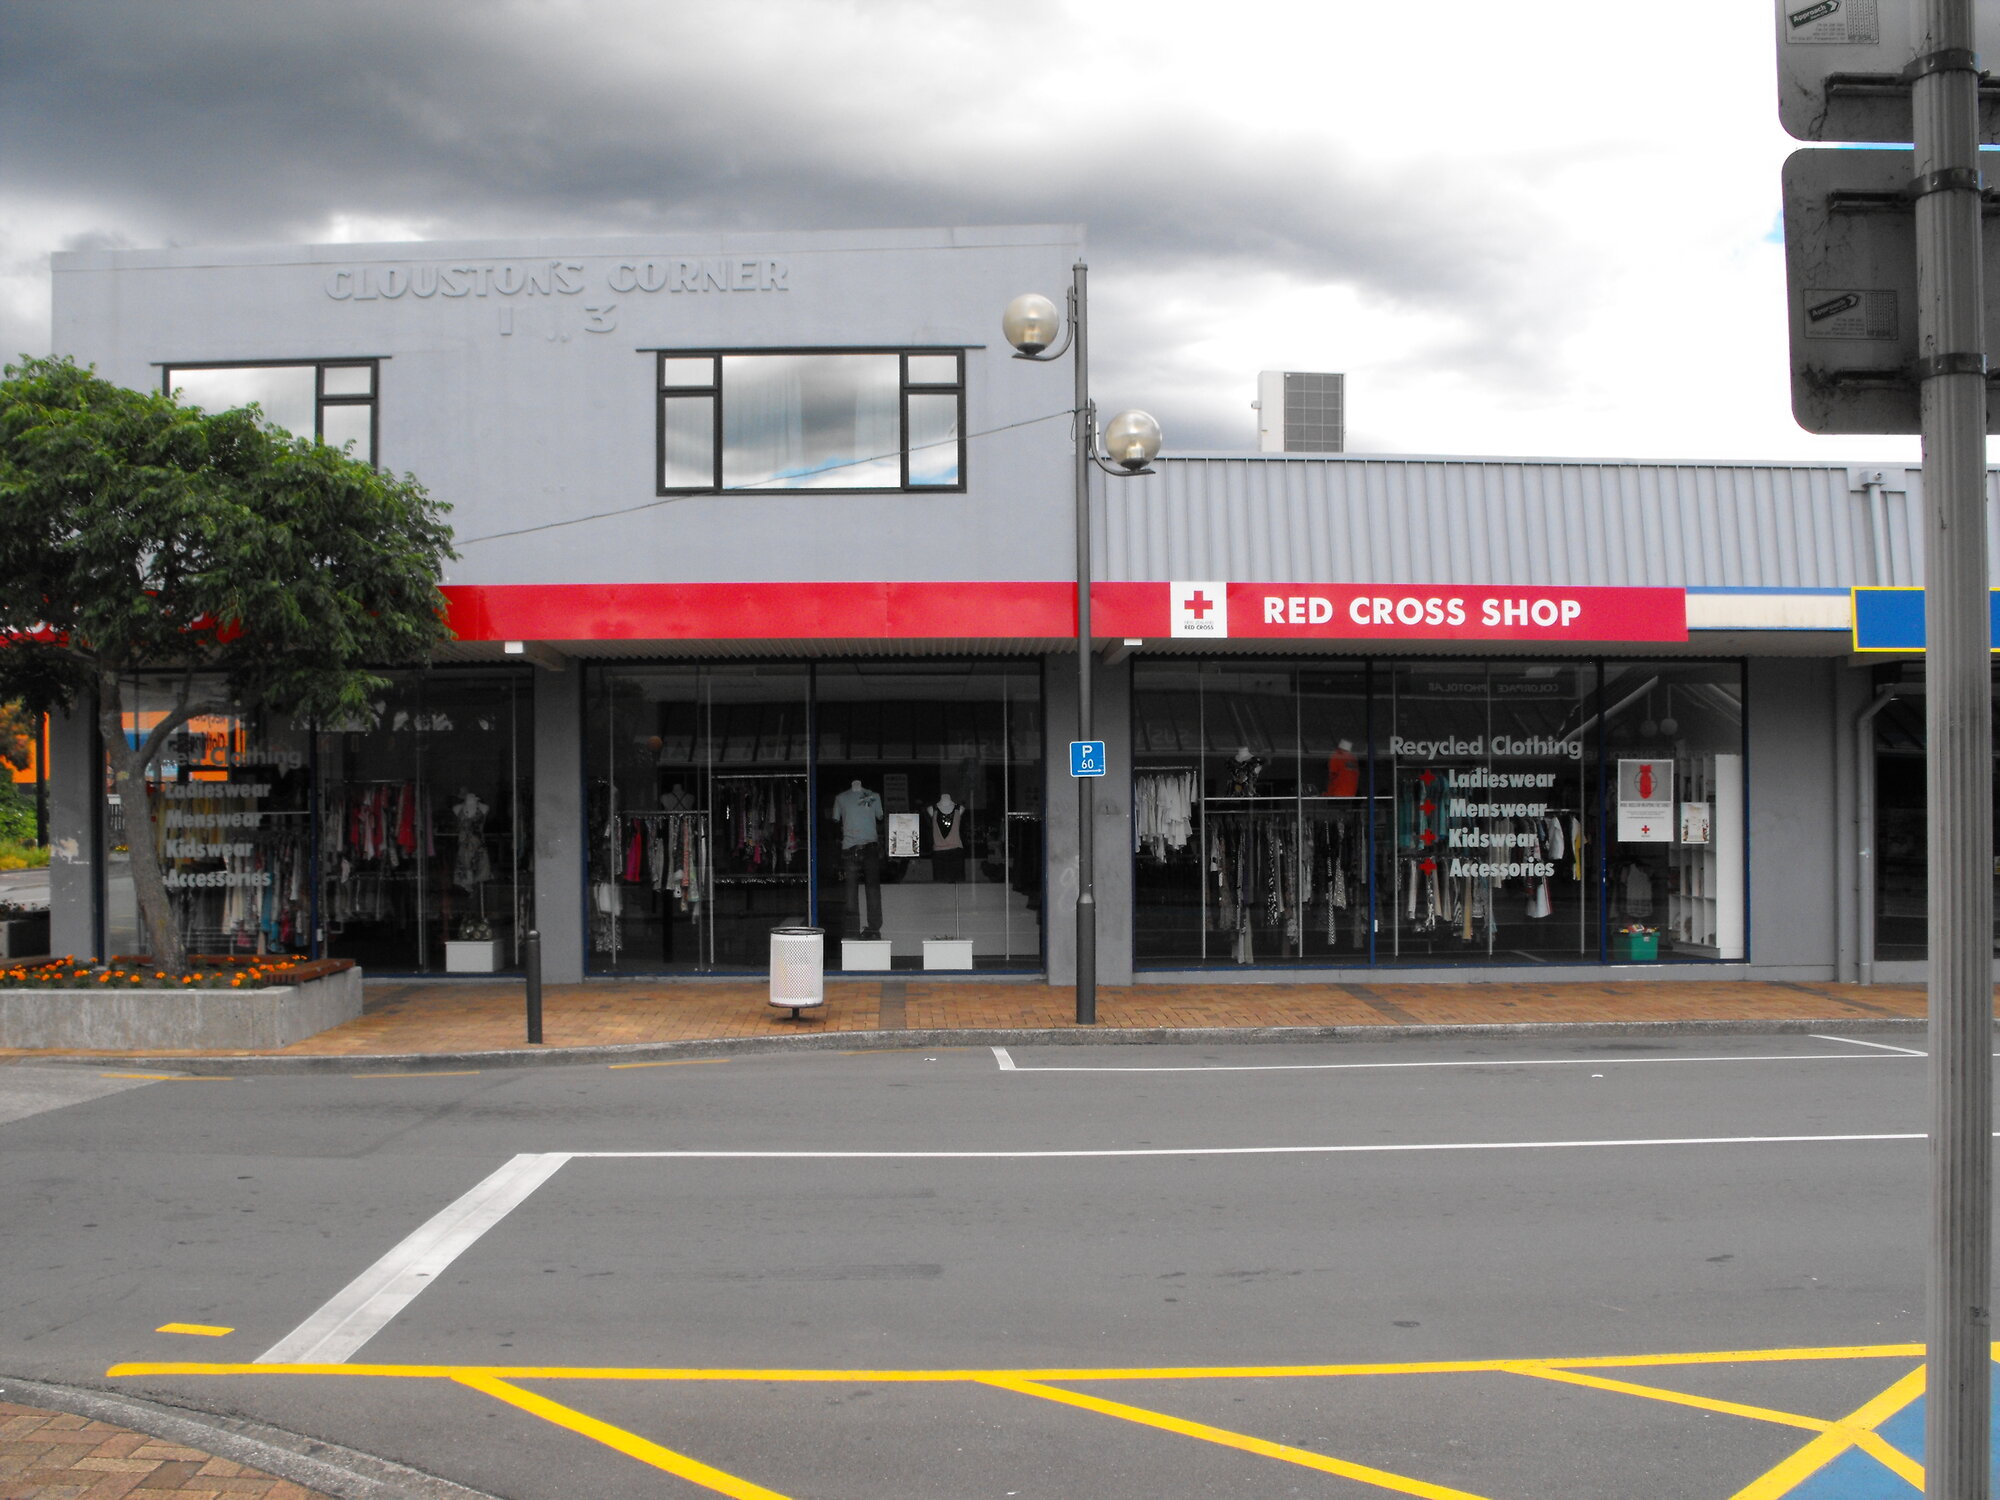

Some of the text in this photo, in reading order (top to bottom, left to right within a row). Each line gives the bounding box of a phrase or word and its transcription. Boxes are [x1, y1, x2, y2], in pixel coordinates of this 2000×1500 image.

[325, 258, 789, 301] CLOUSTON'S CORNER
[1264, 596, 1582, 628] RED CROSS SHOP
[1082, 744, 1093, 758] P
[1389, 735, 1583, 760] Recycled Clothing
[1081, 759, 1094, 769] 60
[1449, 768, 1556, 788] Ladieswear
[165, 780, 271, 799] Ladieswear
[1449, 798, 1547, 817] Menswear
[165, 810, 263, 828] Menswear
[1449, 828, 1539, 848] Kidswear
[165, 839, 253, 858] Kidswear
[1449, 857, 1555, 877] Accessories
[166, 868, 271, 888] Accessories
